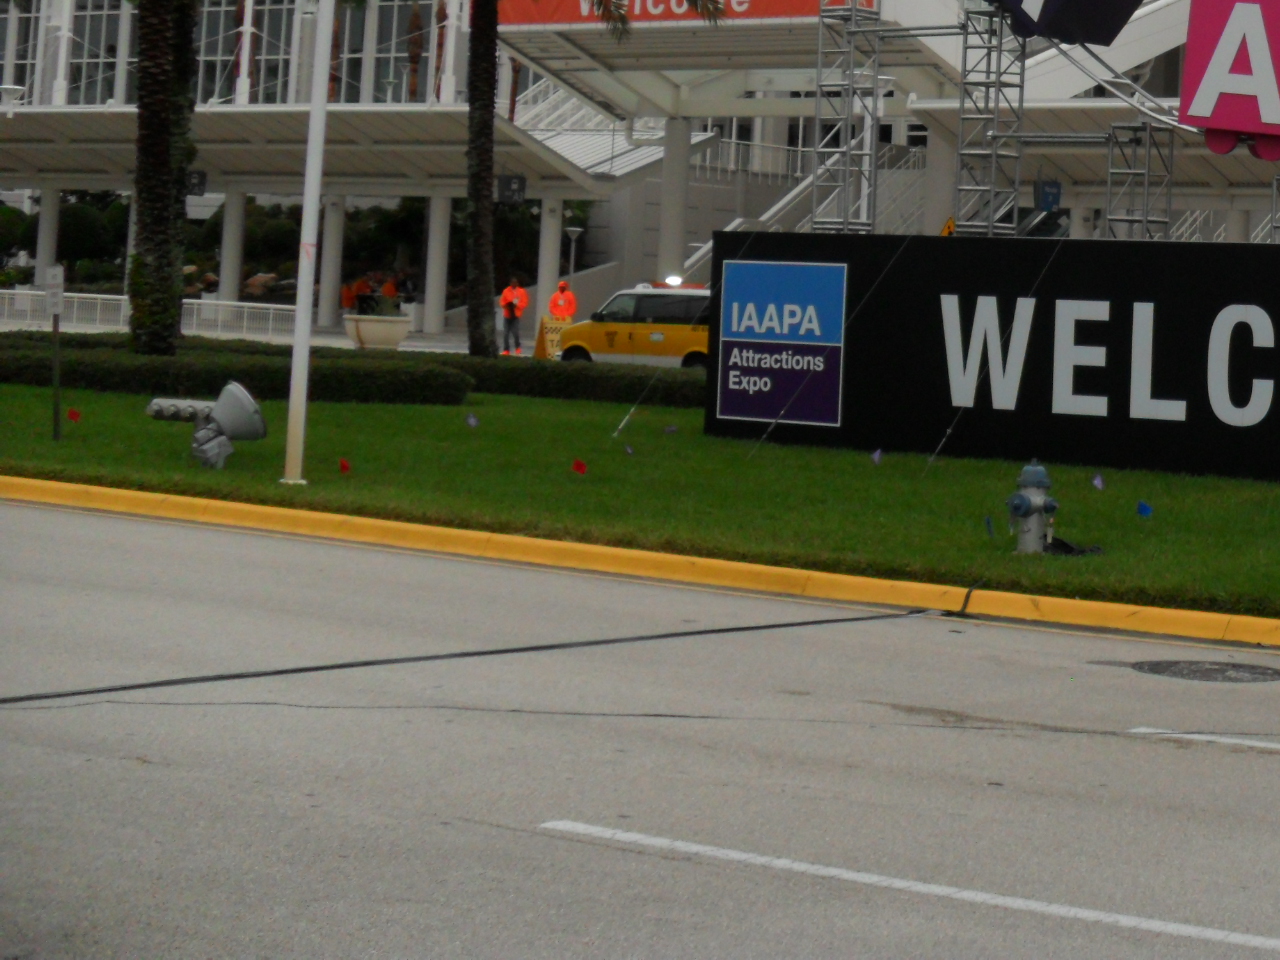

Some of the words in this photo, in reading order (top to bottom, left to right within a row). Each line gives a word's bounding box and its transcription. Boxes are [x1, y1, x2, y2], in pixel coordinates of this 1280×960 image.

[731, 302, 821, 336] IAAPA
[728, 347, 824, 371] Attractions
[728, 371, 771, 394] Expo
